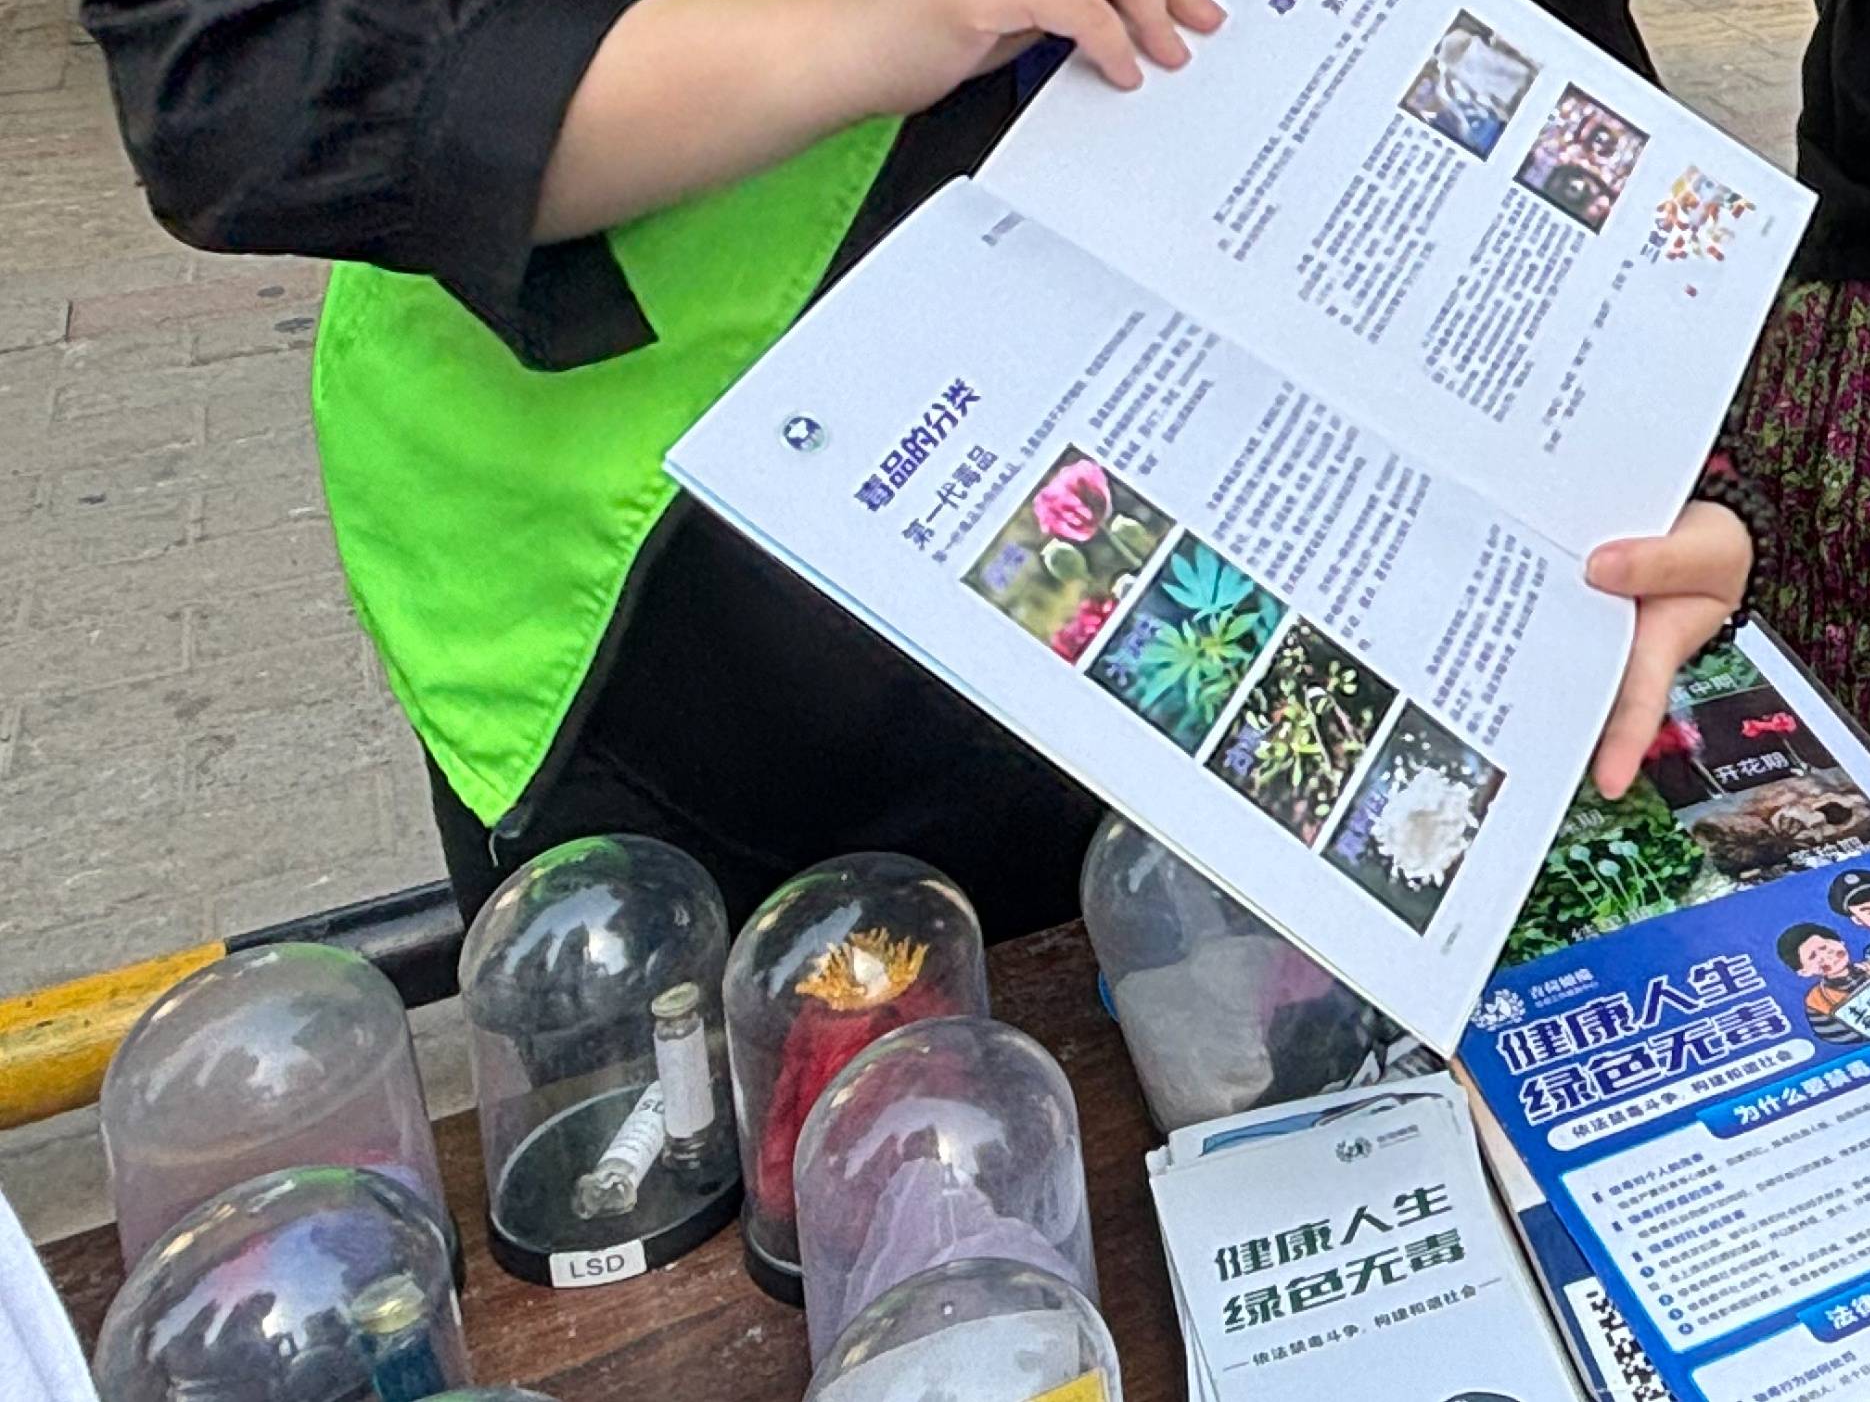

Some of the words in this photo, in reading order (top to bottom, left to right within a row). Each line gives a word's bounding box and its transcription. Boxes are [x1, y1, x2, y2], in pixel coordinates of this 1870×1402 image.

[853, 377, 982, 512] 毒品的分类
[902, 445, 998, 551] 第一代毒品
[1713, 750, 1792, 785] 开花期
[1496, 953, 1767, 1077] 健康人生
[1518, 996, 1793, 1127] 绿色无毒
[569, 1253, 625, 1280] LSD
[1213, 1182, 1453, 1283] 健康人生
[1222, 1228, 1467, 1335] 绿色无毒
